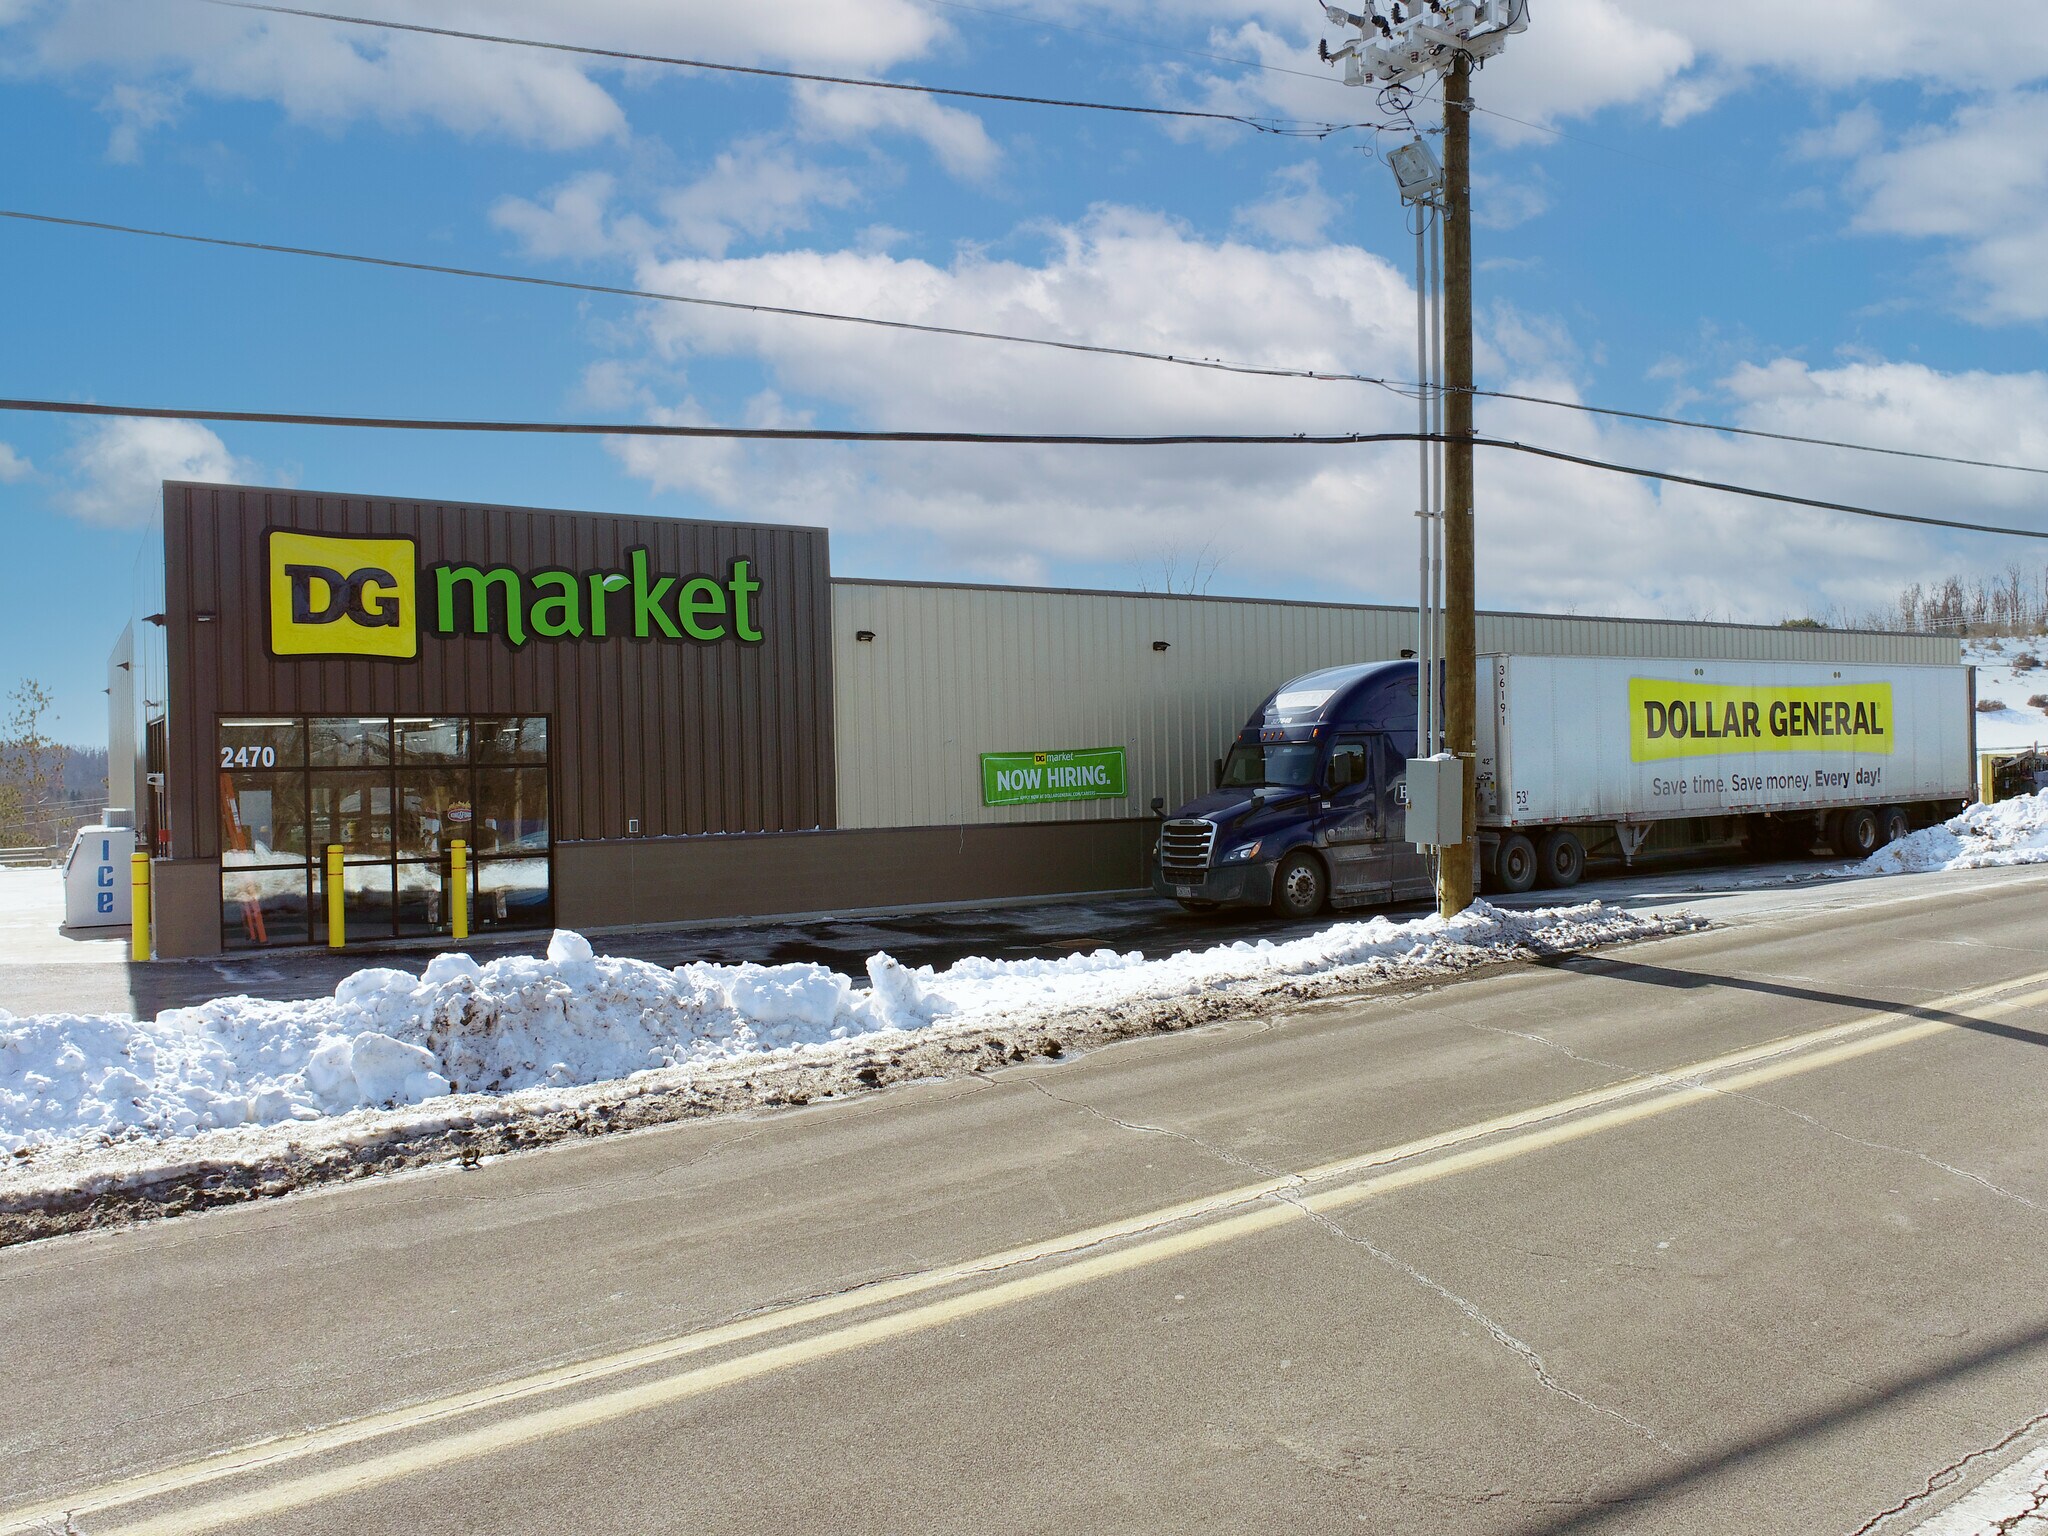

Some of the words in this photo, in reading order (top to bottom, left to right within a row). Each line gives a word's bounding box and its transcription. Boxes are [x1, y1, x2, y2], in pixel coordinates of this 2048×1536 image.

[284, 565, 400, 628] DG
[435, 549, 763, 646] market
[1644, 700, 1761, 739] DOLLAR
[1769, 701, 1884, 737] GENERAL
[220, 746, 275, 769] 2470
[1046, 752, 1074, 763] market
[997, 768, 1042, 792] NOW
[1047, 765, 1111, 788] HIRING.
[1653, 777, 1687, 796] Save
[1692, 774, 1728, 794] time.
[1732, 774, 1762, 792] Save
[1766, 774, 1812, 792] money.
[1815, 770, 1850, 789] Every
[1855, 767, 1881, 787] day!
[1517, 790, 1529, 805] 53'
